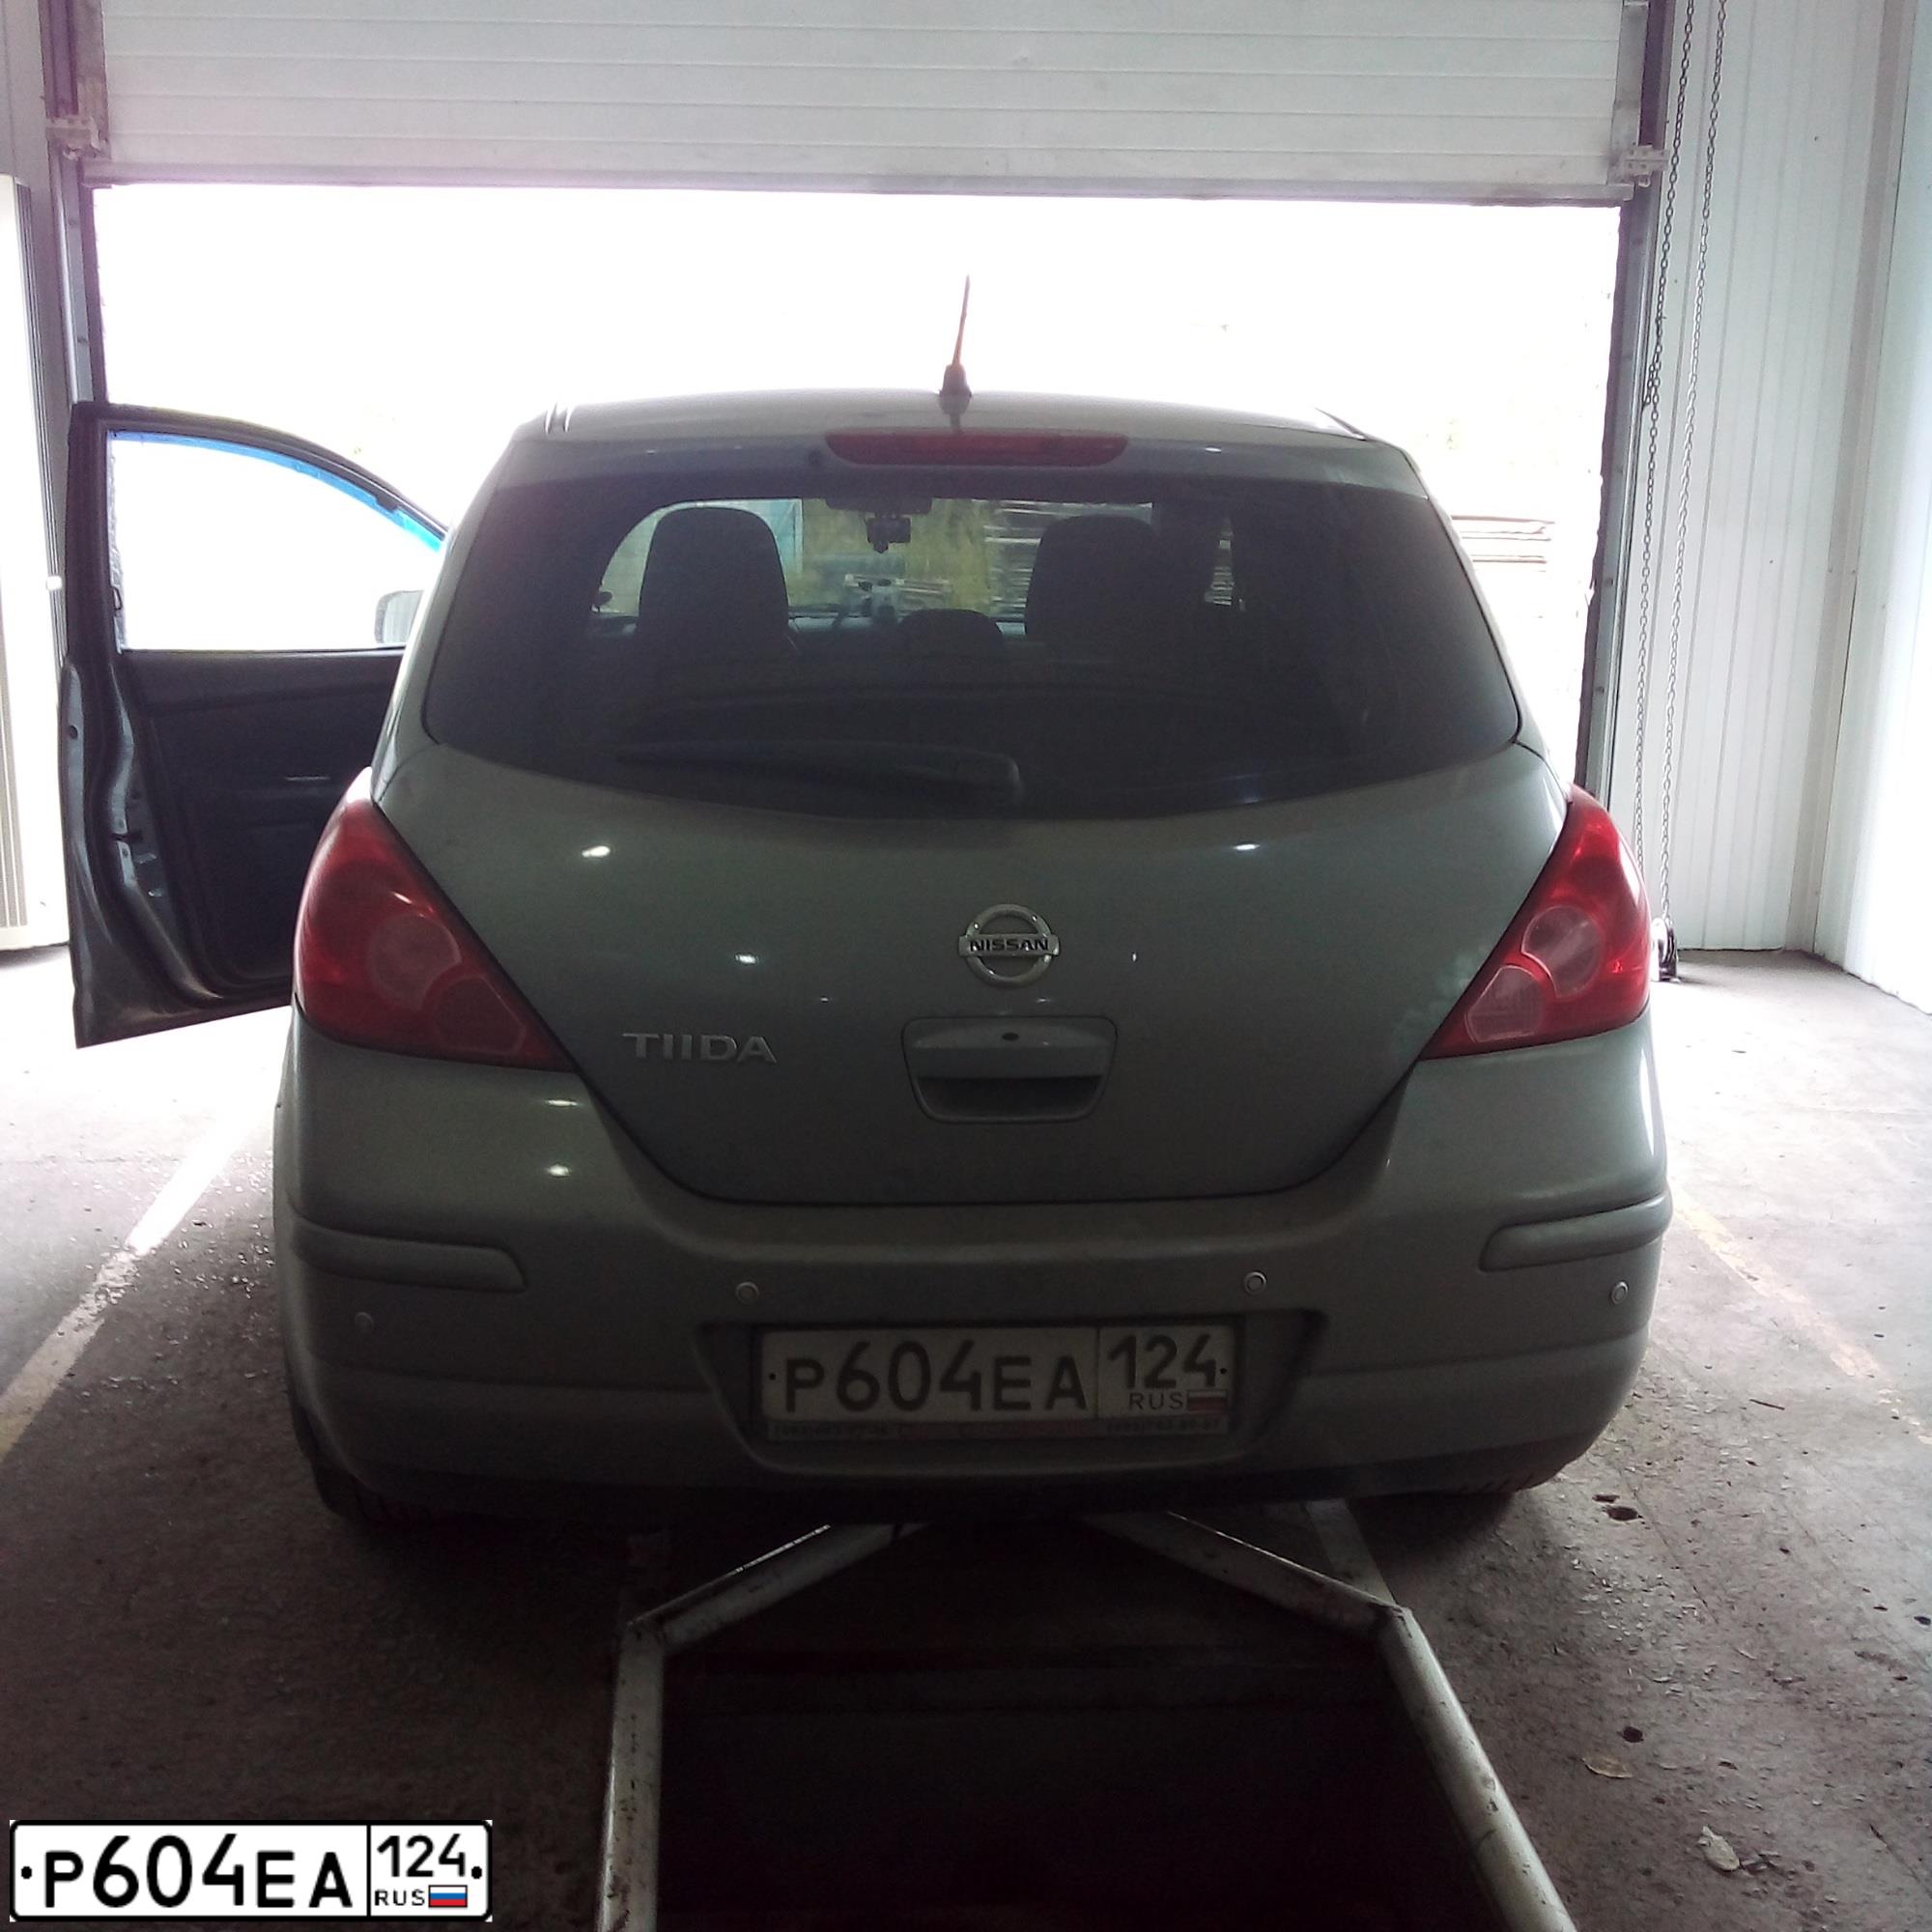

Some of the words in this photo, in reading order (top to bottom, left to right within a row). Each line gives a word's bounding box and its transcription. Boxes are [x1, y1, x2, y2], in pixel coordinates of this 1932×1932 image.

[970, 938, 1049, 952] NISSAN
[622, 1032, 778, 1064] TIIDA
[1106, 1333, 1218, 1389] 124
[1128, 1392, 1184, 1412] RUS
